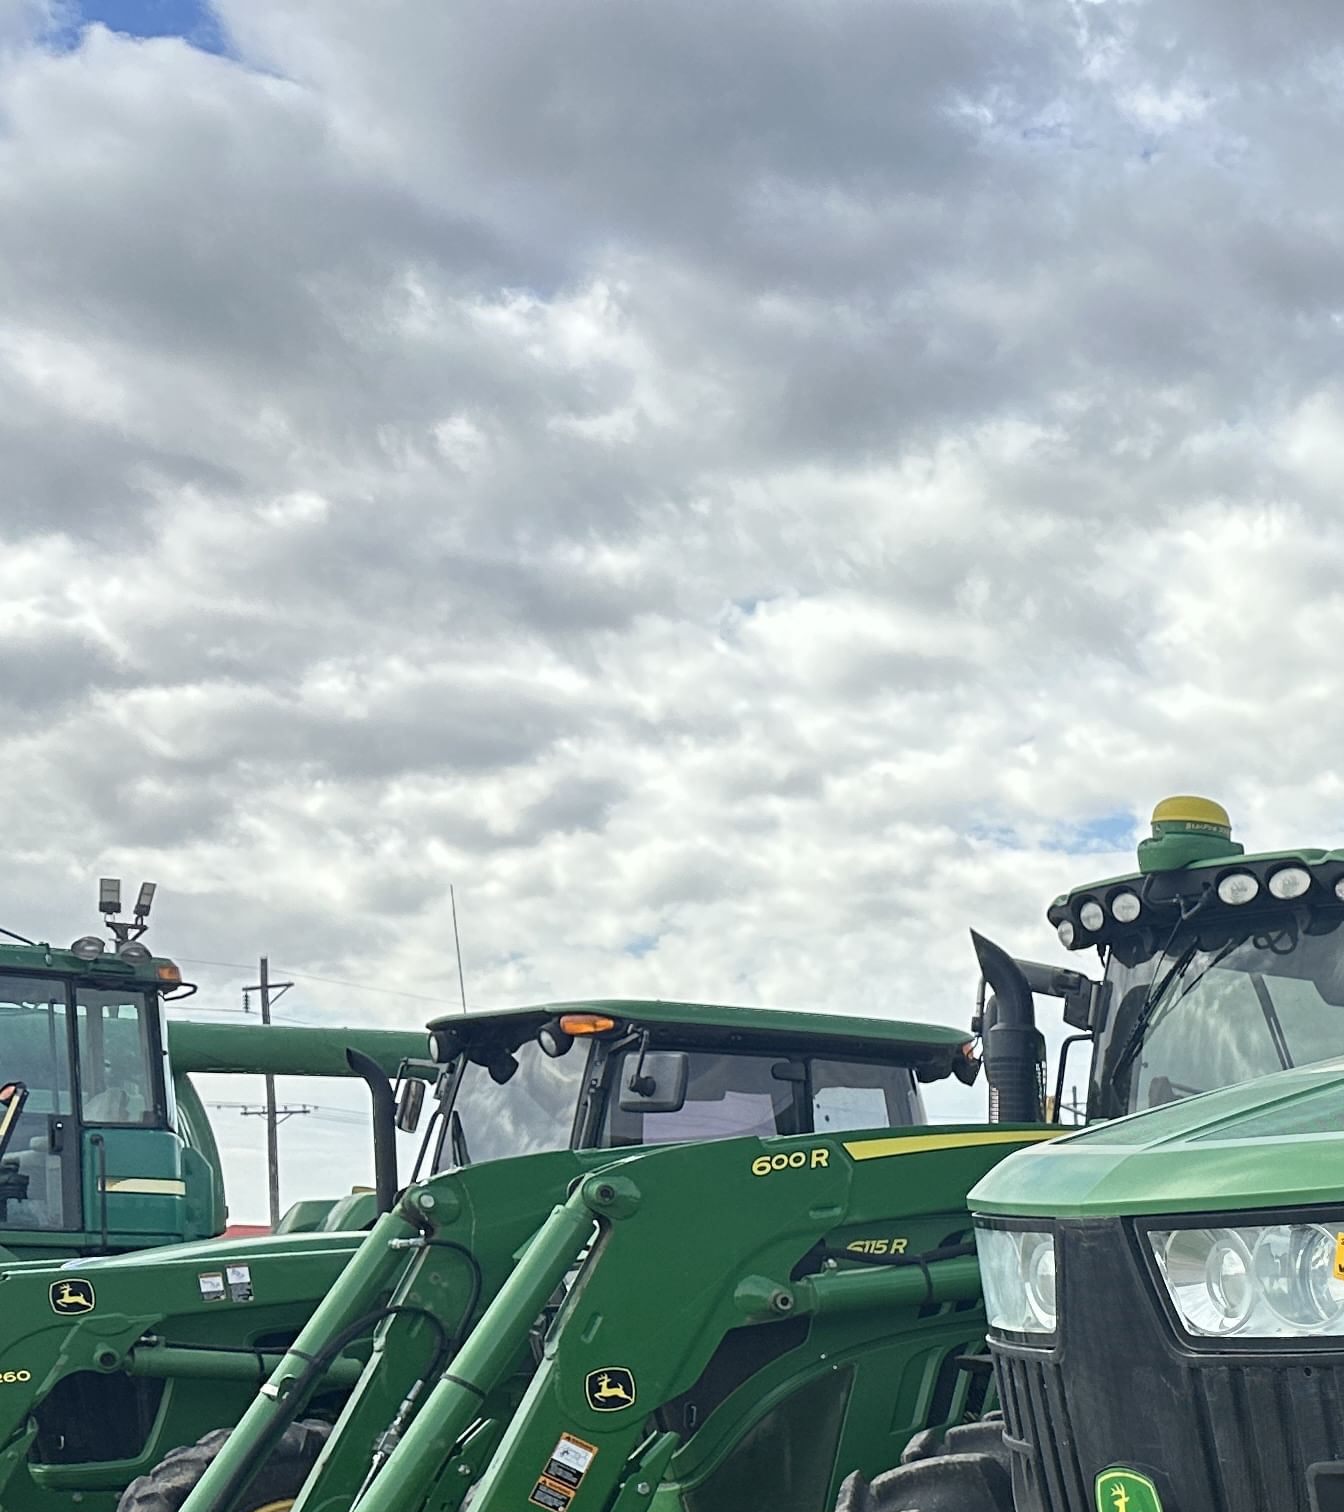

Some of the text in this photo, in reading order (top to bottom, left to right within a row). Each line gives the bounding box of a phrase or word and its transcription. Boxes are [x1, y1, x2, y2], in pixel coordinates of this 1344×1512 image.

[751, 1147, 830, 1177] 600 R
[889, 1238, 908, 1254] R
[0, 1369, 31, 1384] 60
